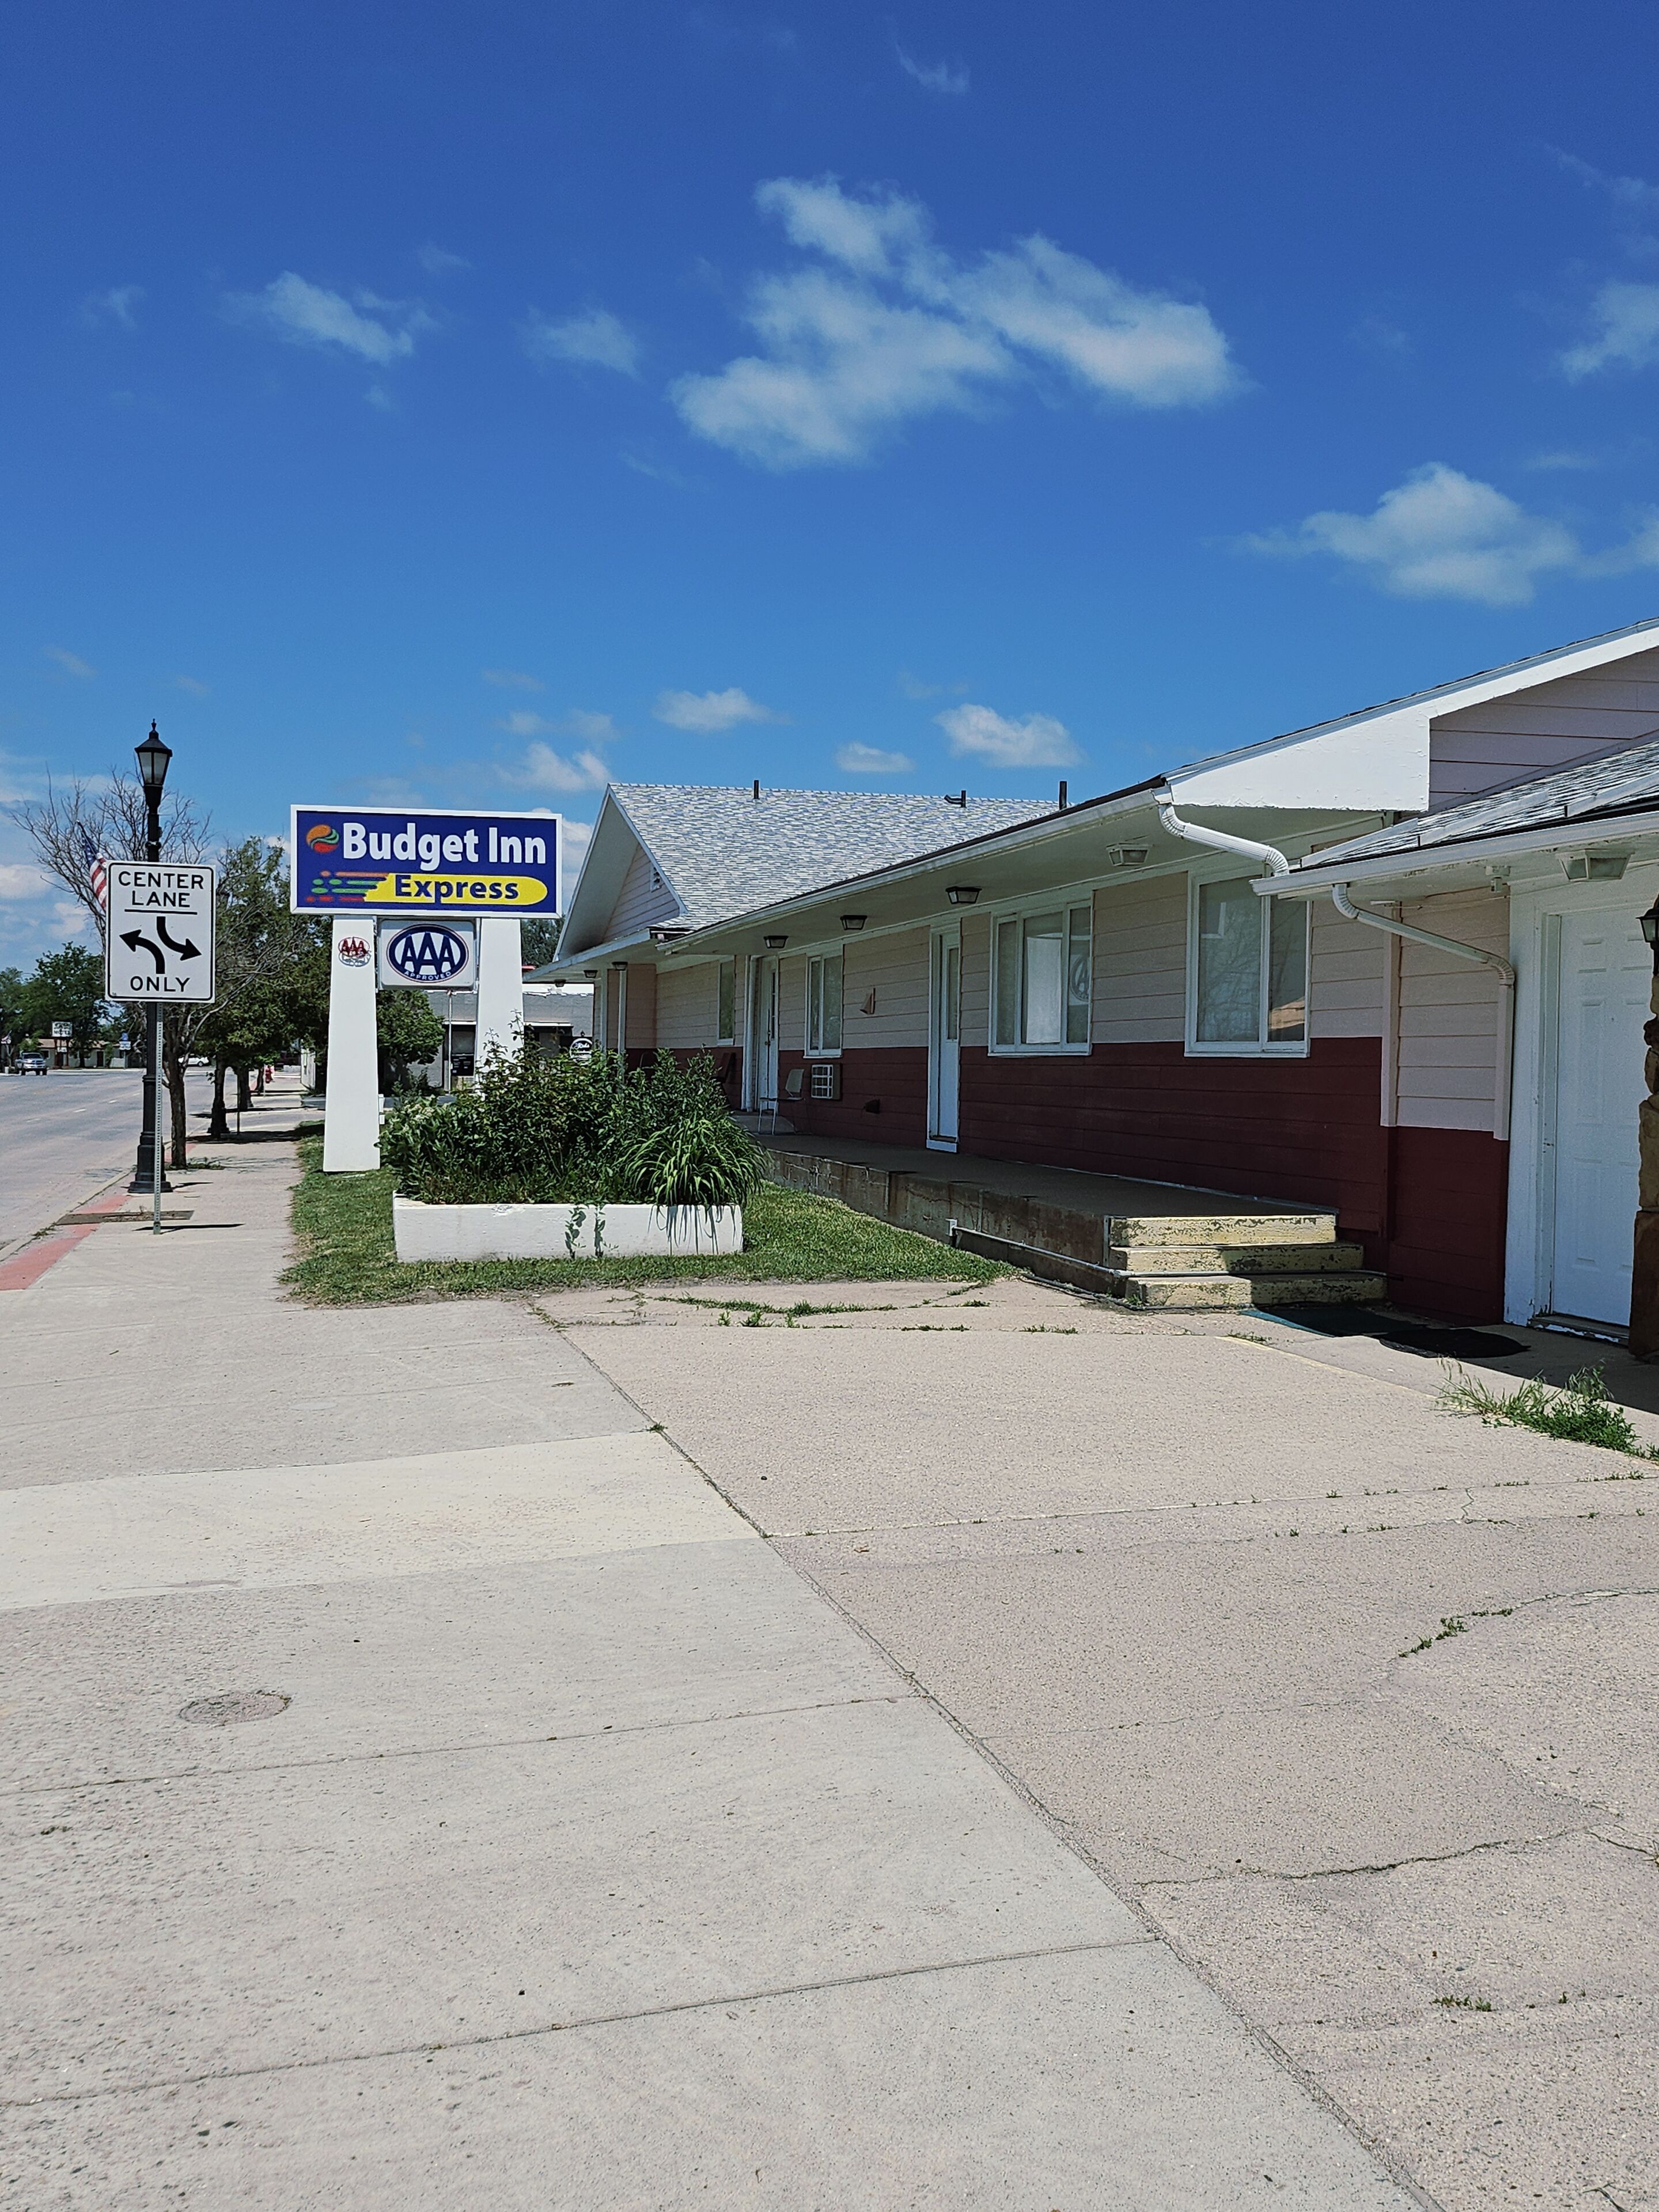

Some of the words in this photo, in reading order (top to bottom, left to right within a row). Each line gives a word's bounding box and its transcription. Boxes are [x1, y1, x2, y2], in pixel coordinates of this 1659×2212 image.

[343, 823, 479, 871] Budget
[489, 827, 546, 864] Inn
[118, 871, 204, 889] CENTER
[395, 874, 520, 903] Express
[132, 890, 190, 908] LANE
[400, 931, 457, 975] AAA
[130, 976, 191, 992] ONLY
[404, 970, 452, 980] APPROVED
